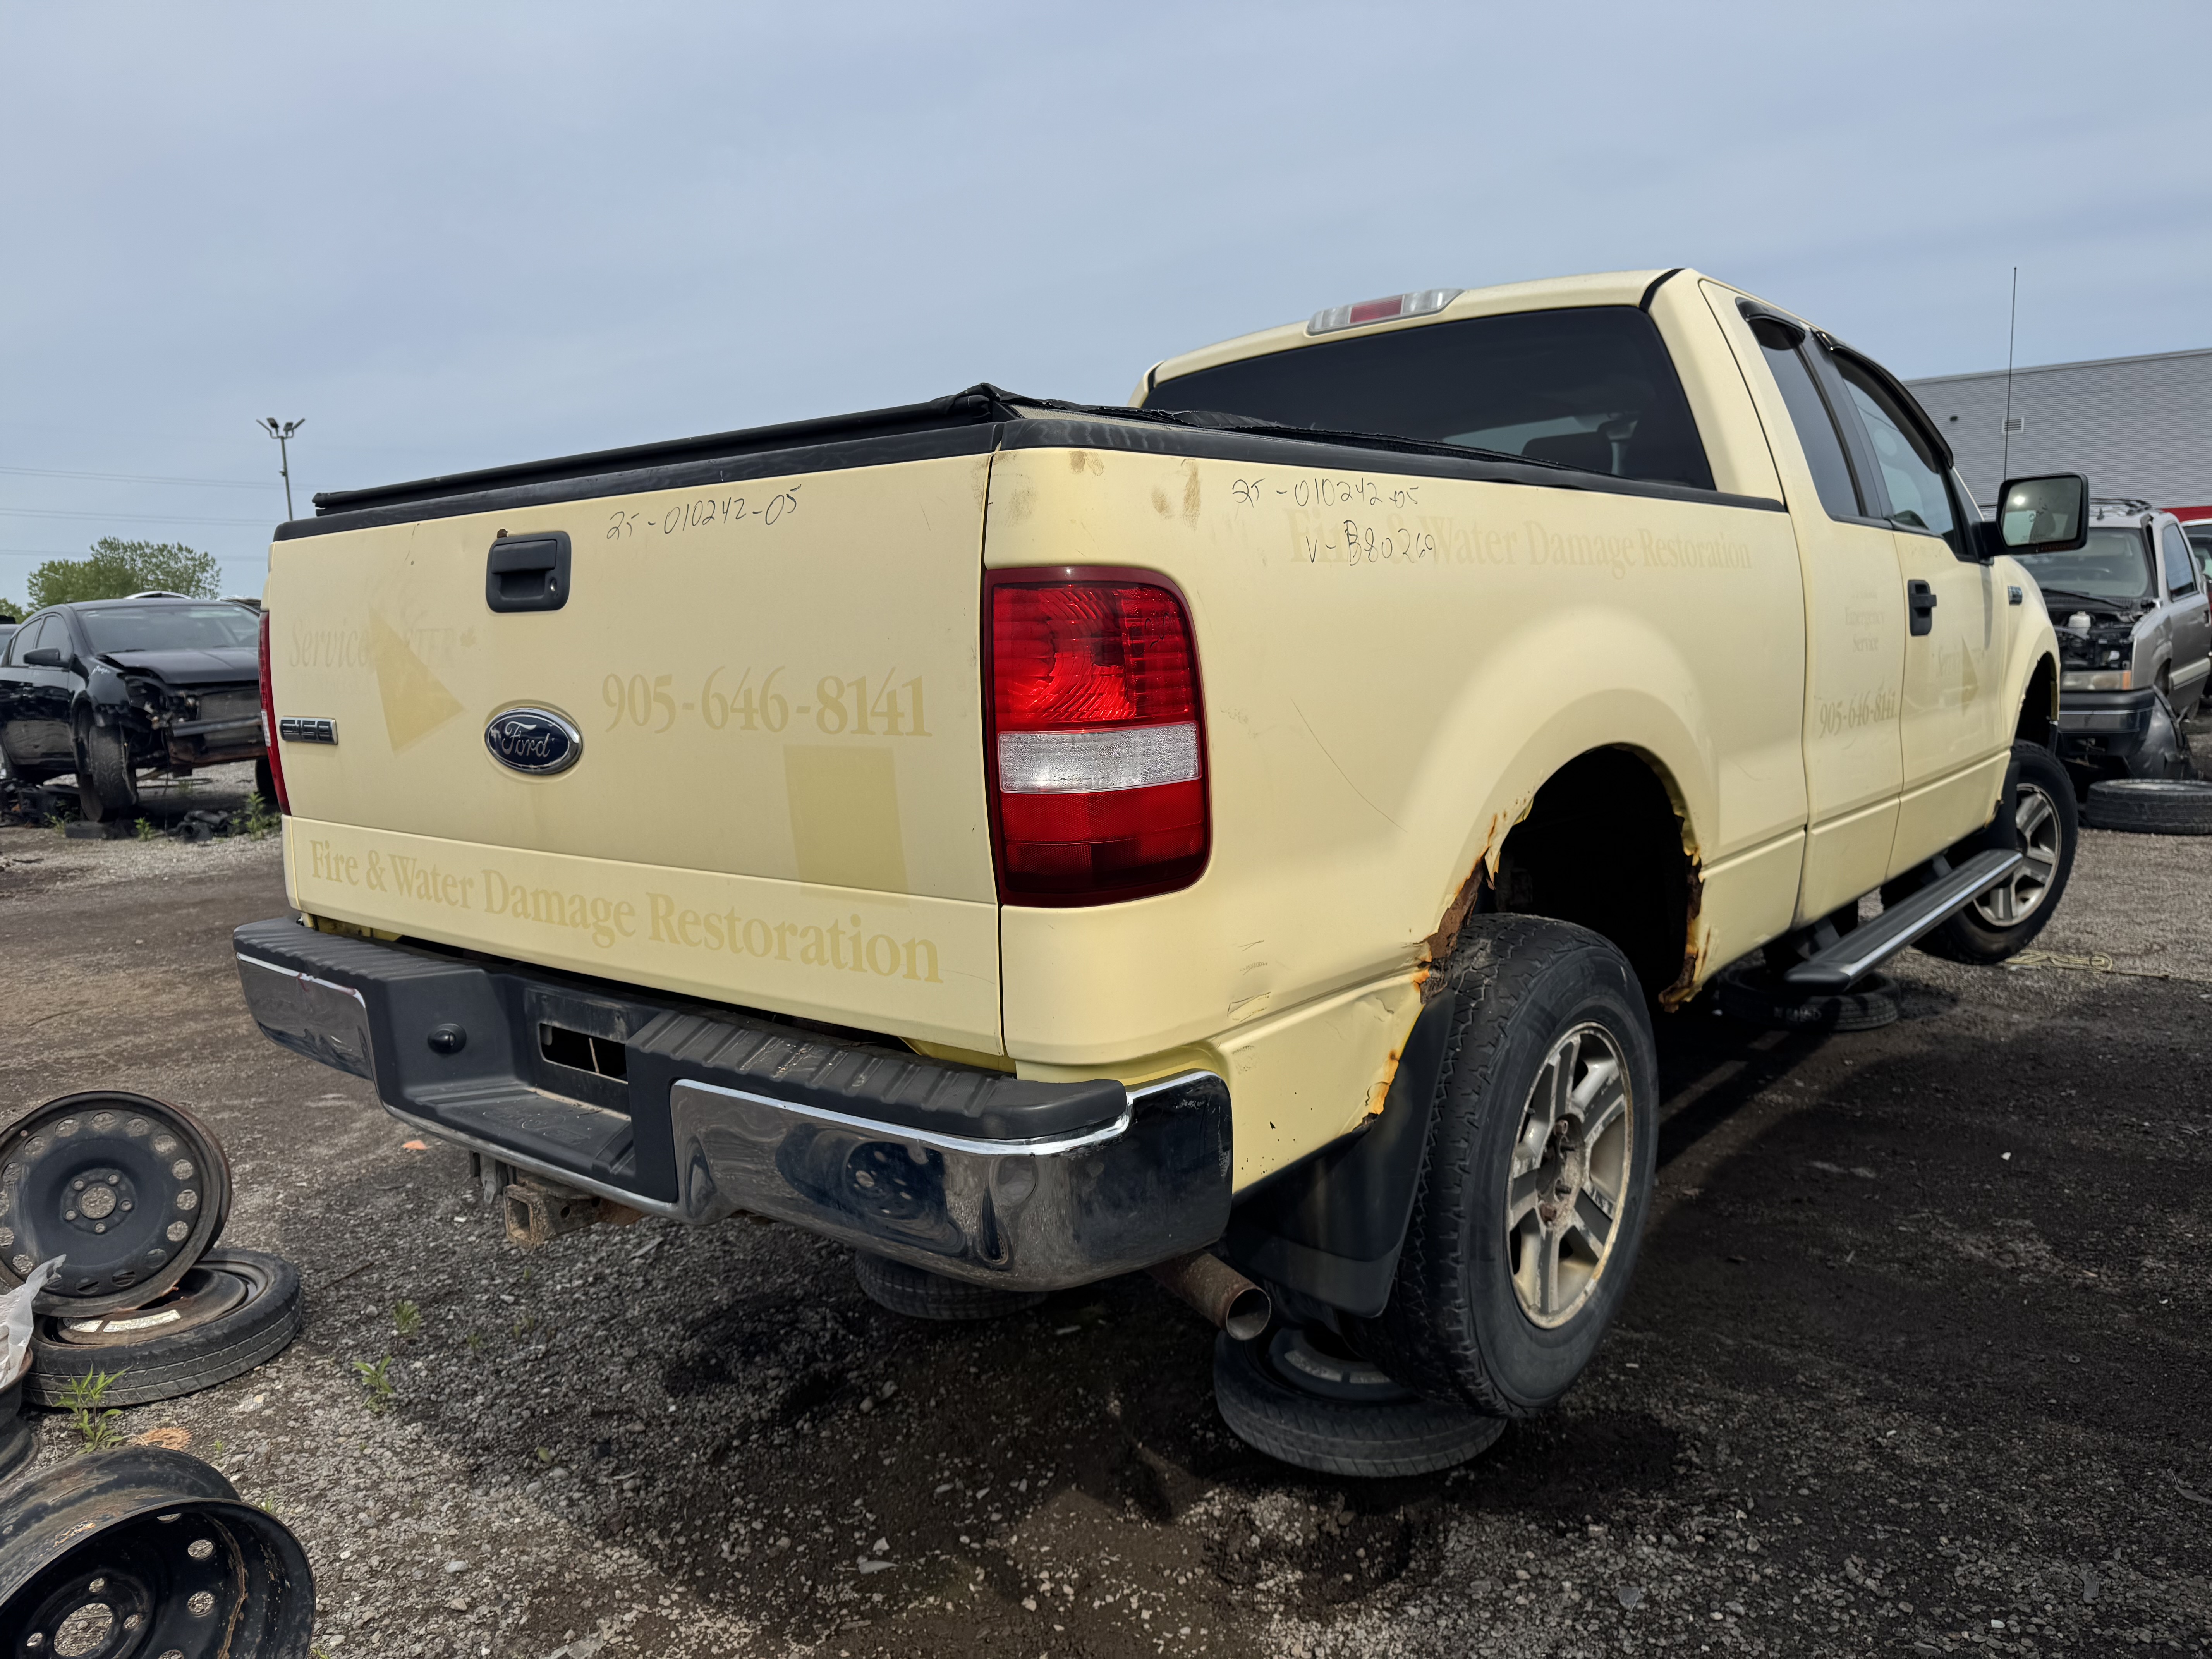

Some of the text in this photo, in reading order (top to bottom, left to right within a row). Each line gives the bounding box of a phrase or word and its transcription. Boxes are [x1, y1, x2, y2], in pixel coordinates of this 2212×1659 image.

[1417, 515, 1518, 565] Water
[1522, 520, 1635, 580] Damage
[1638, 527, 1753, 570] Restoration
[601, 665, 933, 737] 905-646-8141
[501, 721, 550, 758] Ford
[309, 840, 944, 984] Fire & Water Damage Restoration
